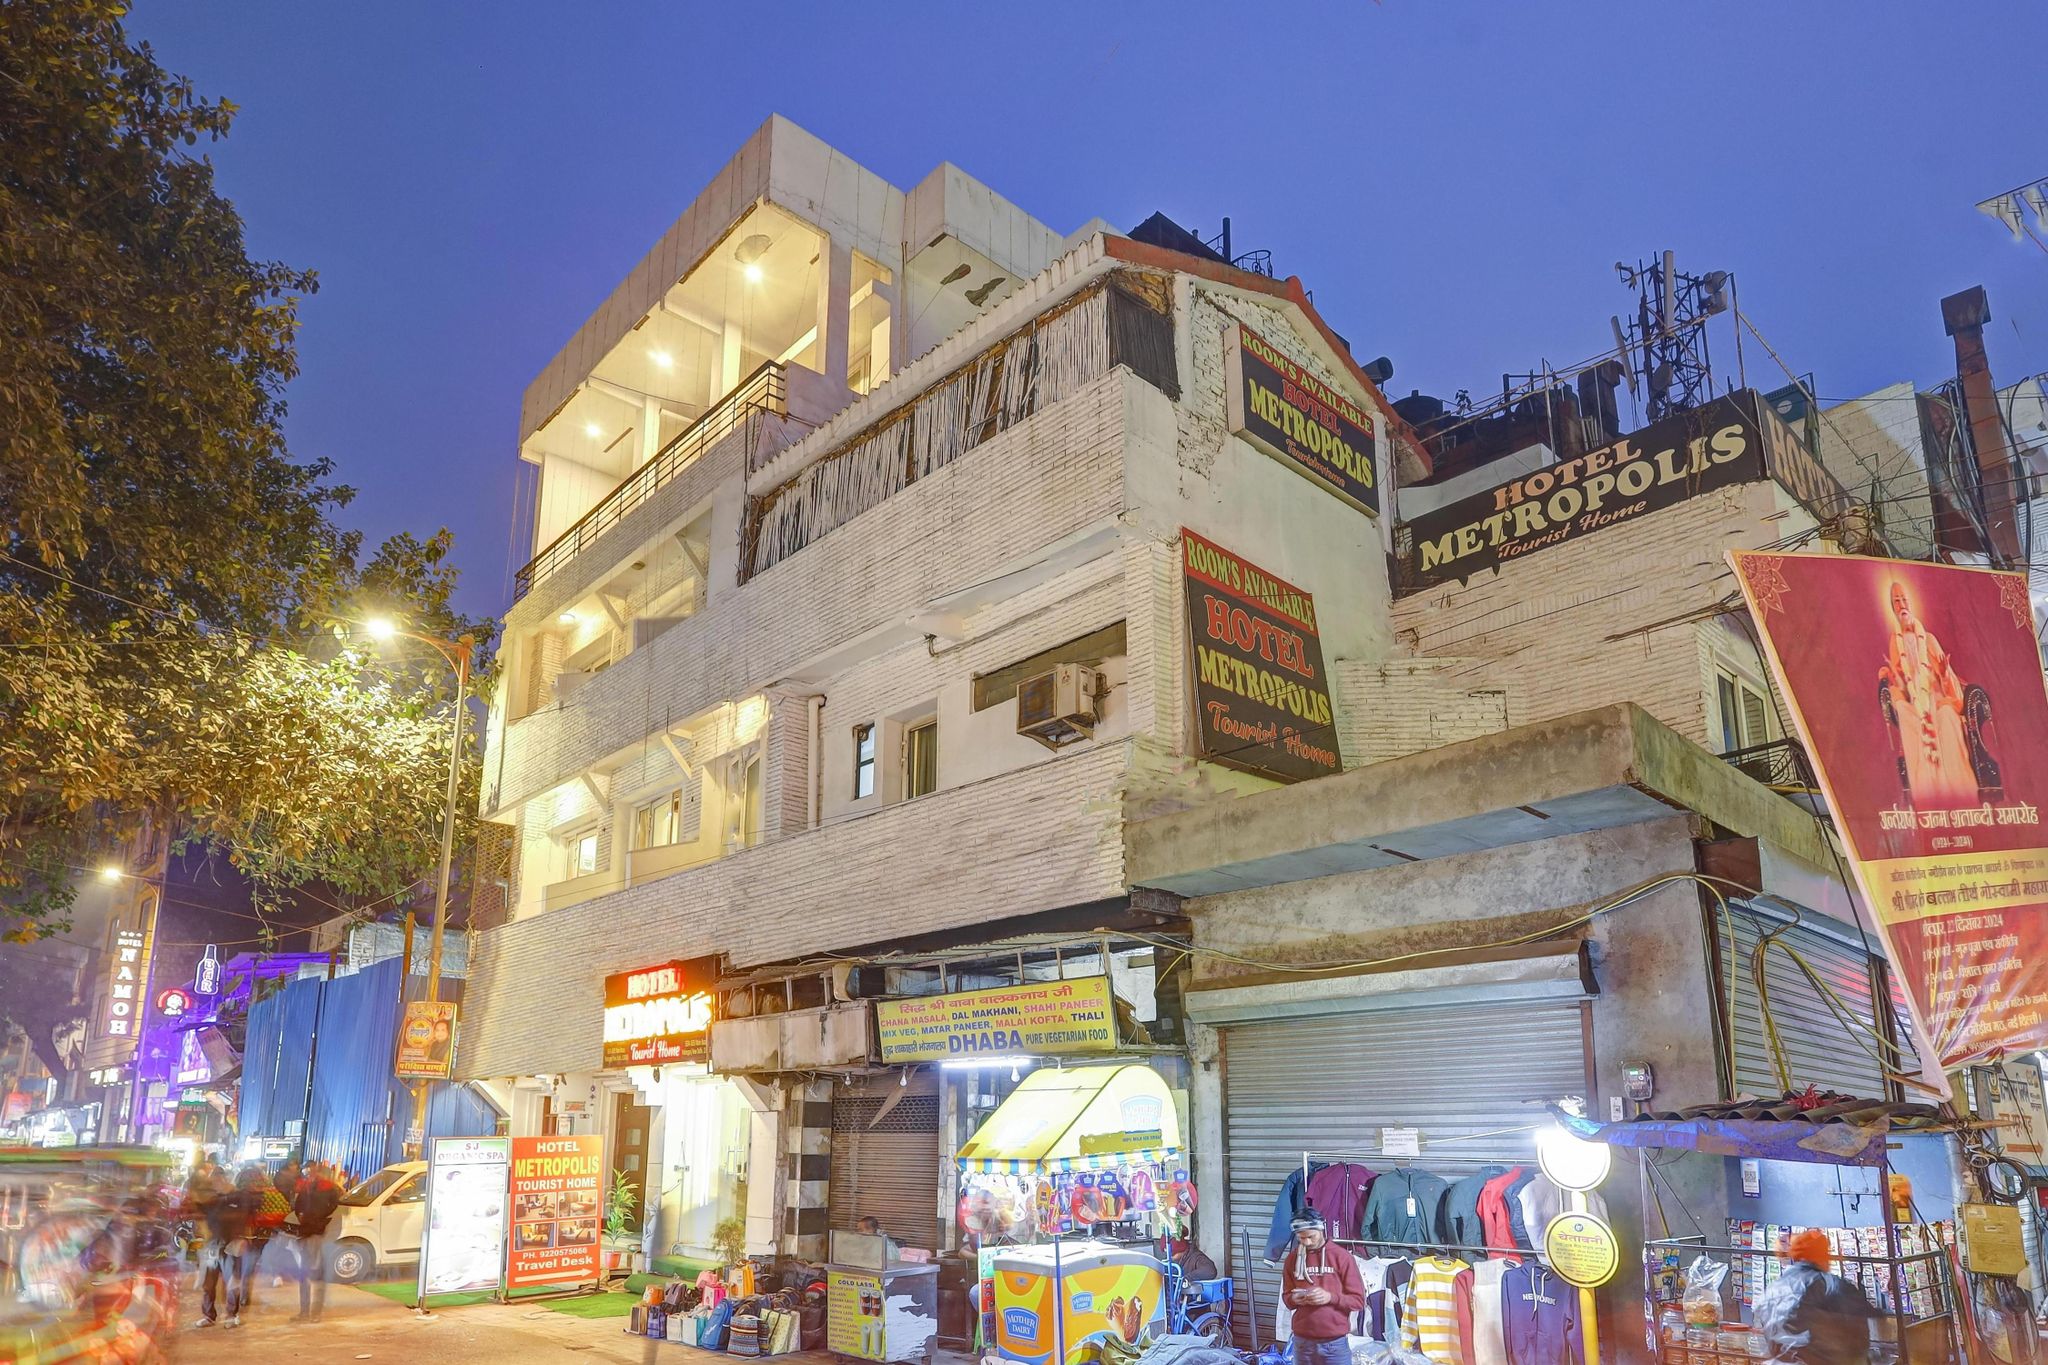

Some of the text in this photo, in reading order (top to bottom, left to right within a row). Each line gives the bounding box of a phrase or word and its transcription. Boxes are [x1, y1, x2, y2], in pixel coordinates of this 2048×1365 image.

[1242, 330, 1372, 434] ROOM'S AVAILABLE
[1282, 379, 1341, 437] HOTEL
[1249, 378, 1373, 489] METROPOLIS
[1493, 438, 1643, 512] HOTEL
[1419, 423, 1747, 572] METROPOLIS
[1497, 499, 1648, 560] Tourist Home
[1186, 536, 1315, 632] ROOM'S AVAILABLE
[1204, 595, 1315, 680] HOTEL
[1198, 644, 1332, 726] METROPOLIS
[1208, 700, 1336, 769] Tourist Home
[1950, 801, 1994, 829] शताब्दी
[1994, 801, 2040, 826] समारोह
[2022, 880, 2048, 896] महारा
[1983, 914, 2004, 929] 2024
[118, 938, 143, 947] HOTEL
[200, 958, 215, 993] BAR
[627, 968, 678, 999] HOTEL
[109, 948, 138, 1035] NAMOH
[930, 999, 945, 1010] श्री
[1052, 985, 1073, 997] जी
[880, 998, 1104, 1028] CHANA MASALA, DAL MAKHANI, SHAHI PANEER
[881, 1011, 1105, 1038] MIX VEG, MATAR PANEER, MALAI KOFTA, THALI
[630, 1037, 656, 1060] Tourist
[657, 1040, 681, 1058] Home
[948, 1029, 1025, 1053] DHABA
[1025, 1028, 1109, 1044] PURE VEGETARIAN FOOD
[486, 1151, 505, 1160] SPA
[536, 1141, 580, 1153] HOTEL
[515, 1156, 600, 1178] METROPOLIS
[516, 1177, 597, 1191] TOURIST HOME
[516, 1255, 593, 1271] Travel Desk
[1006, 1313, 1037, 1330] MOTHER
[1012, 1324, 1031, 1336] DAIRY
